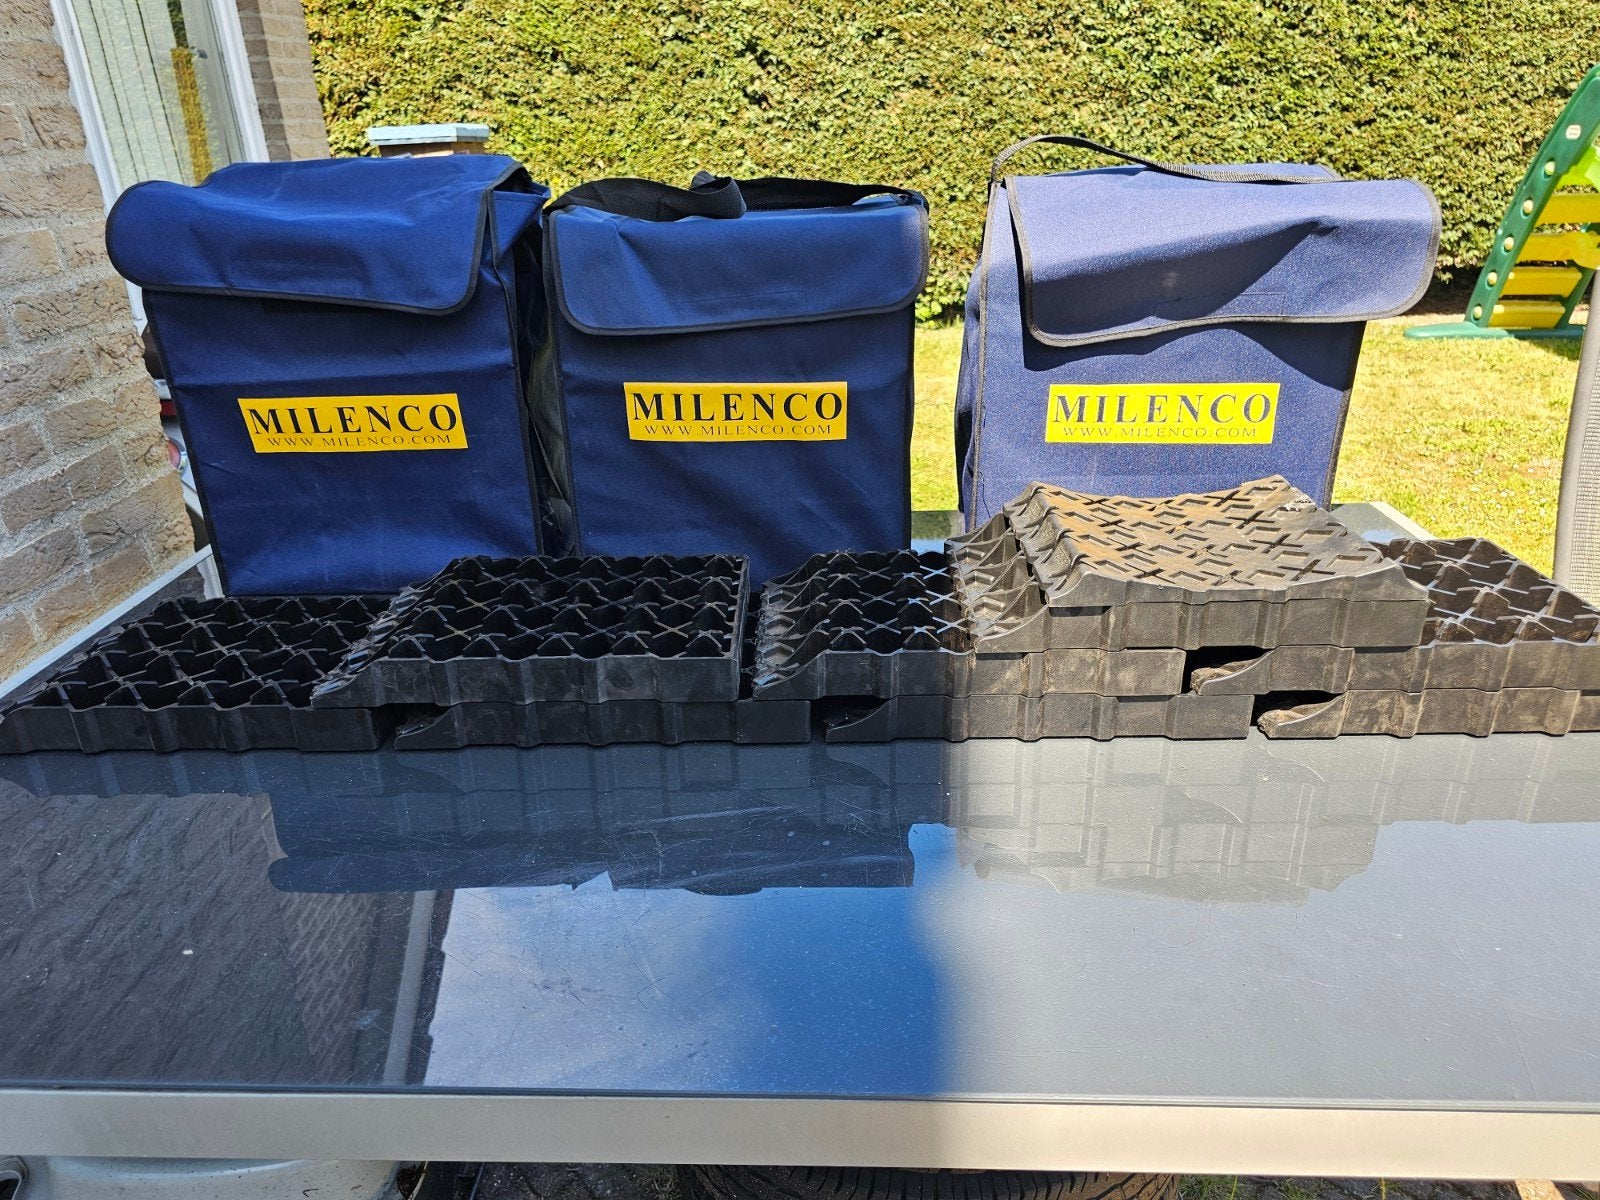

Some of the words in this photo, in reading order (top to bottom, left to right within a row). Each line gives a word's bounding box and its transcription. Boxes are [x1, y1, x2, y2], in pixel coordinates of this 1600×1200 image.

[632, 392, 842, 422] MILENCO
[1054, 393, 1271, 424] MILENCO
[246, 404, 457, 435] MILENCO
[644, 424, 831, 436] WWW.MILENCO.COM
[267, 434, 451, 447] WWW.MILENCO.COM
[1063, 427, 1256, 438] WWW.MILENCO.COM
